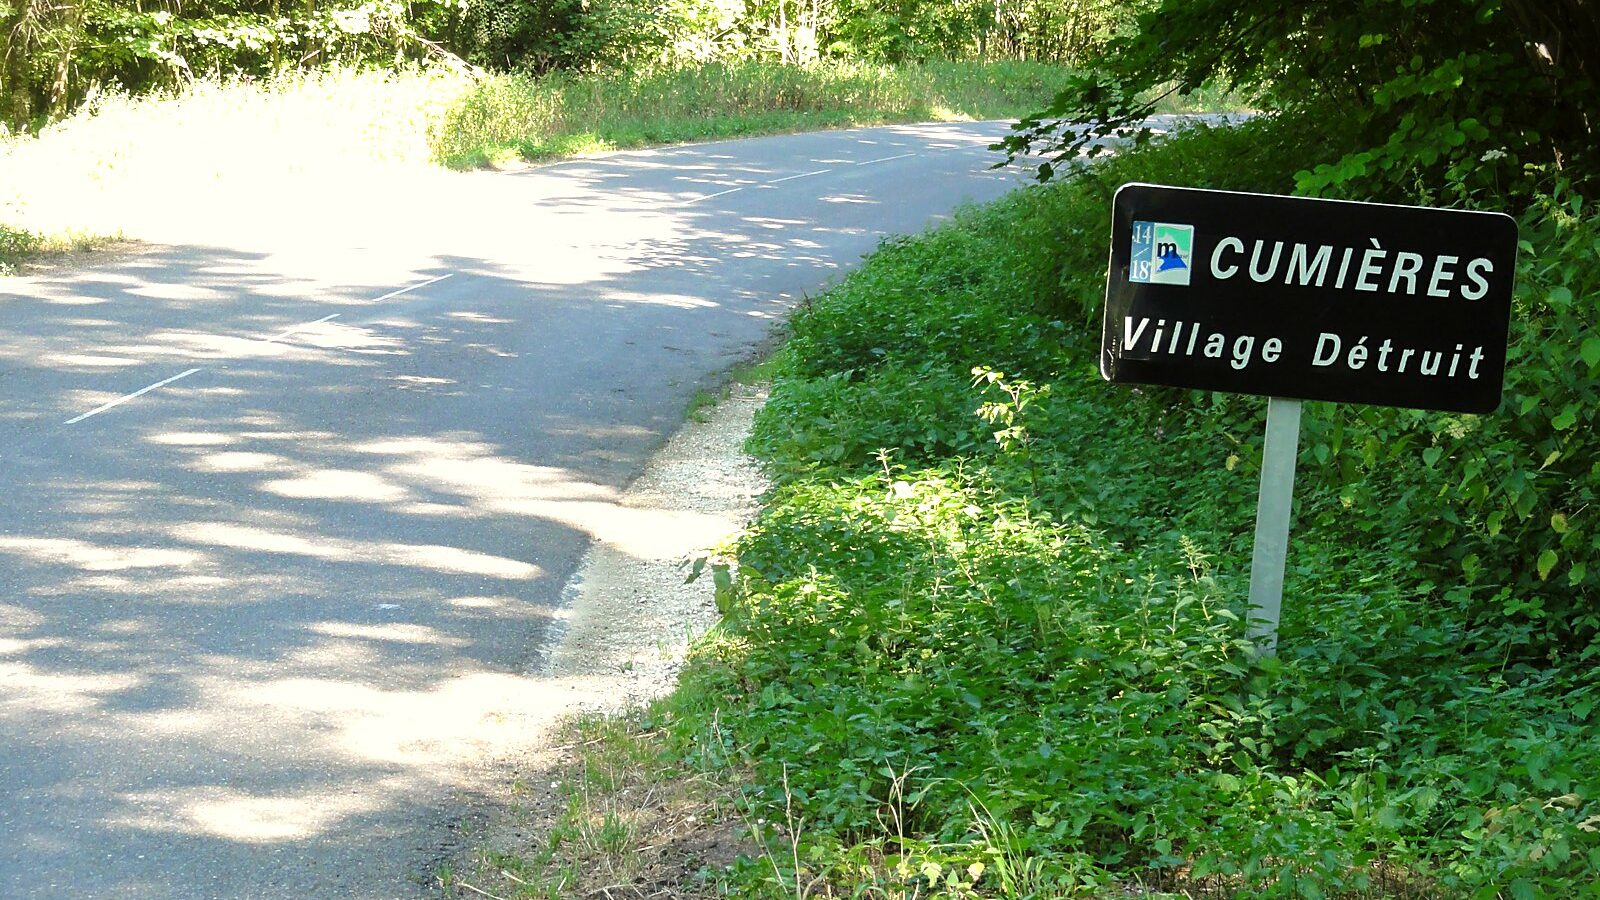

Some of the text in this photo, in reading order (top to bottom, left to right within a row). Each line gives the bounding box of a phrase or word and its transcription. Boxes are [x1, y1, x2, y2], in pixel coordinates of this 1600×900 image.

[1132, 224, 1152, 245] 14
[1131, 259, 1151, 280] 18
[1210, 236, 1494, 301] CUMIÈRES
[1123, 315, 1484, 379] Village Détruit
